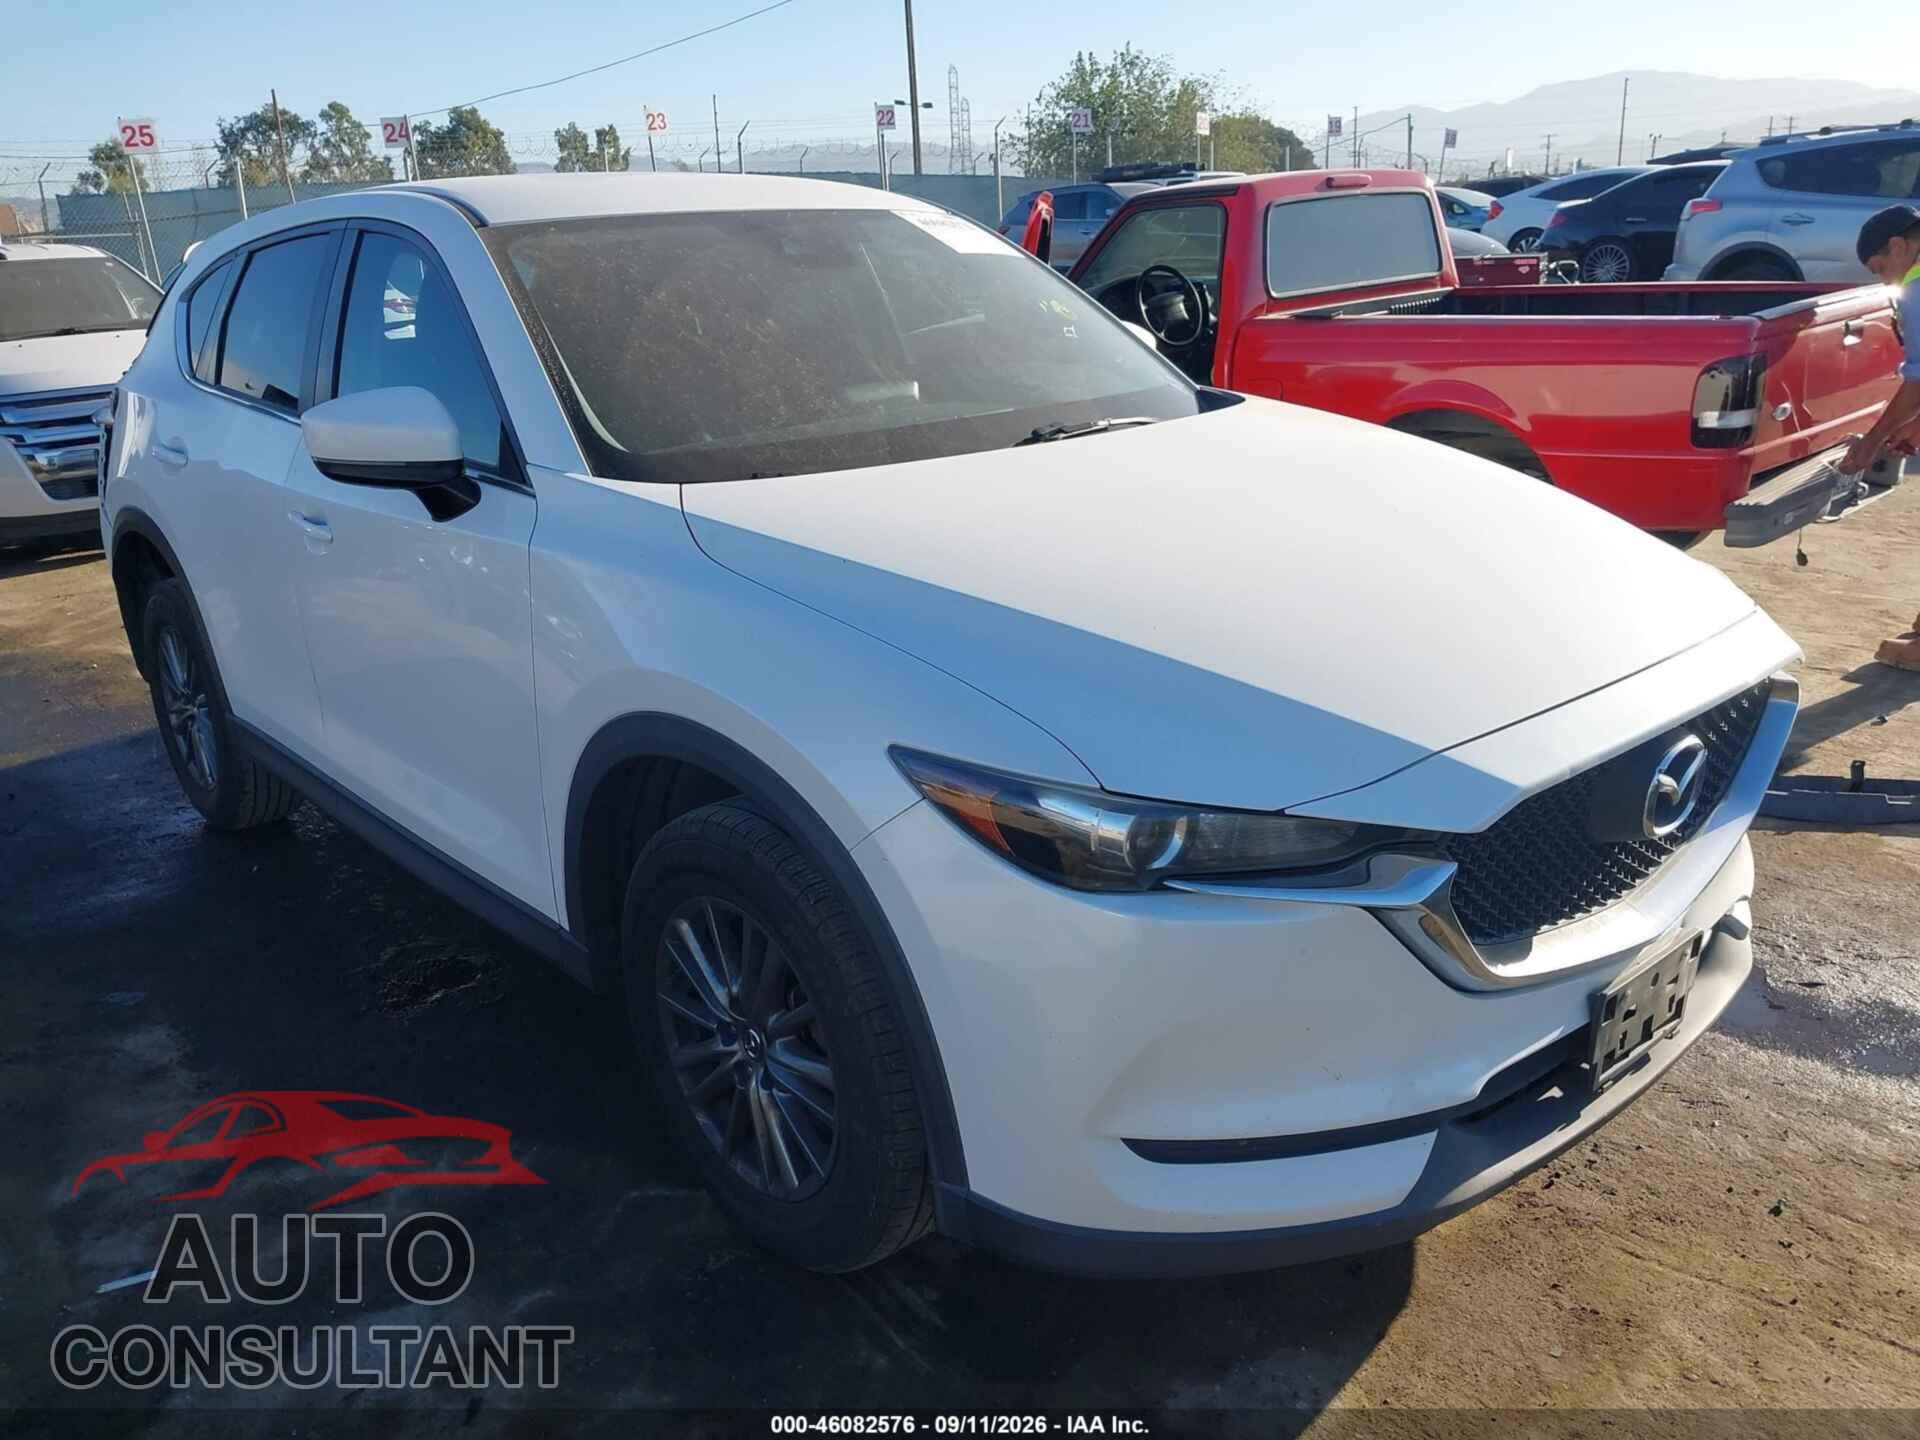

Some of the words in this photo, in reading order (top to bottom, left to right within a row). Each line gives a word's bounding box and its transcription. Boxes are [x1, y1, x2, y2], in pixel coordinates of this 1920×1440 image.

[646, 112, 667, 131] 23
[876, 110, 896, 126] 22
[1071, 112, 1089, 128] 21
[121, 125, 155, 147] 25
[383, 122, 409, 143] 24
